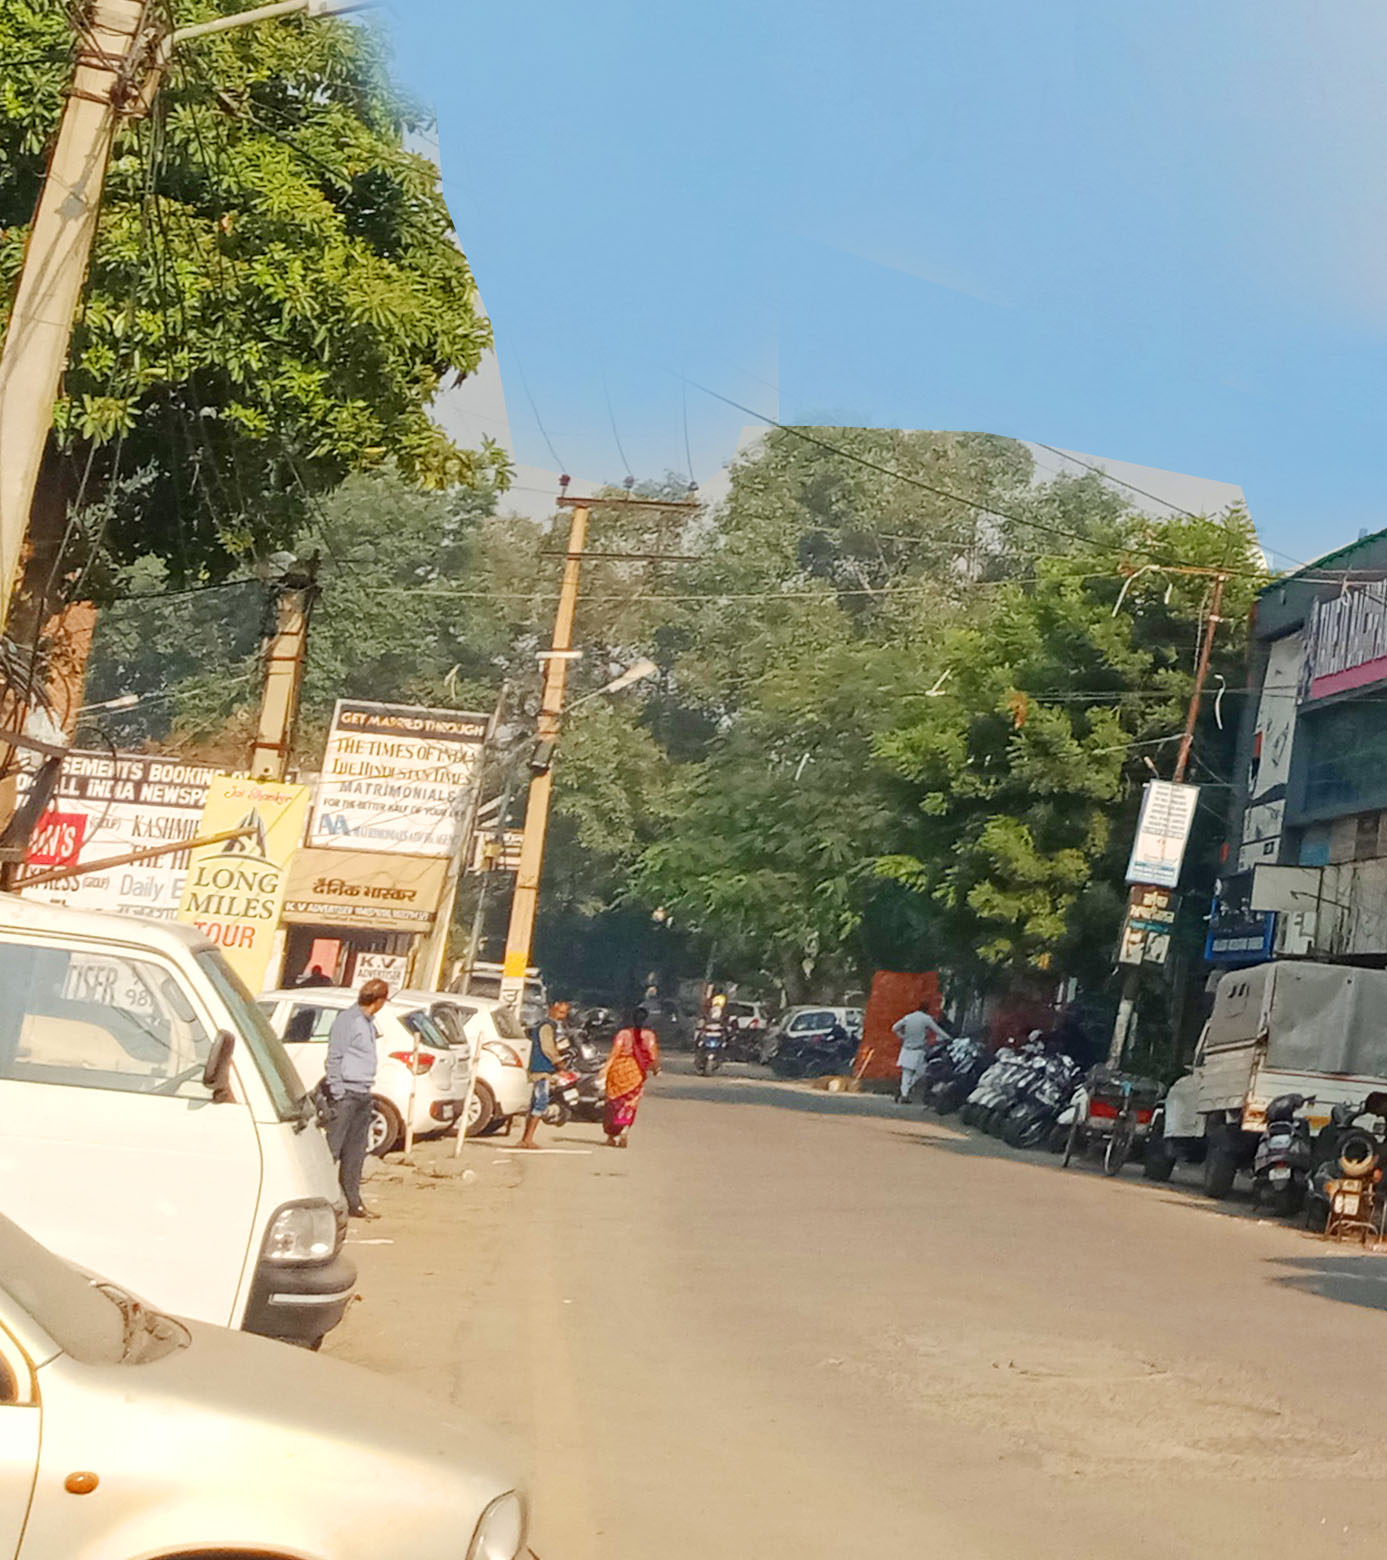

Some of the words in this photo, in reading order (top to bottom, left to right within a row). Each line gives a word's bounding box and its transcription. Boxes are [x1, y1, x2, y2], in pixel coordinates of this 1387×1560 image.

[341, 712, 365, 725] GET
[337, 738, 365, 755] THE
[369, 741, 415, 760] TIMES
[417, 745, 434, 761] OF
[120, 874, 164, 904] Daily
[194, 867, 280, 895] LONG
[312, 877, 362, 897] दैनिक
[185, 892, 276, 921] MILES
